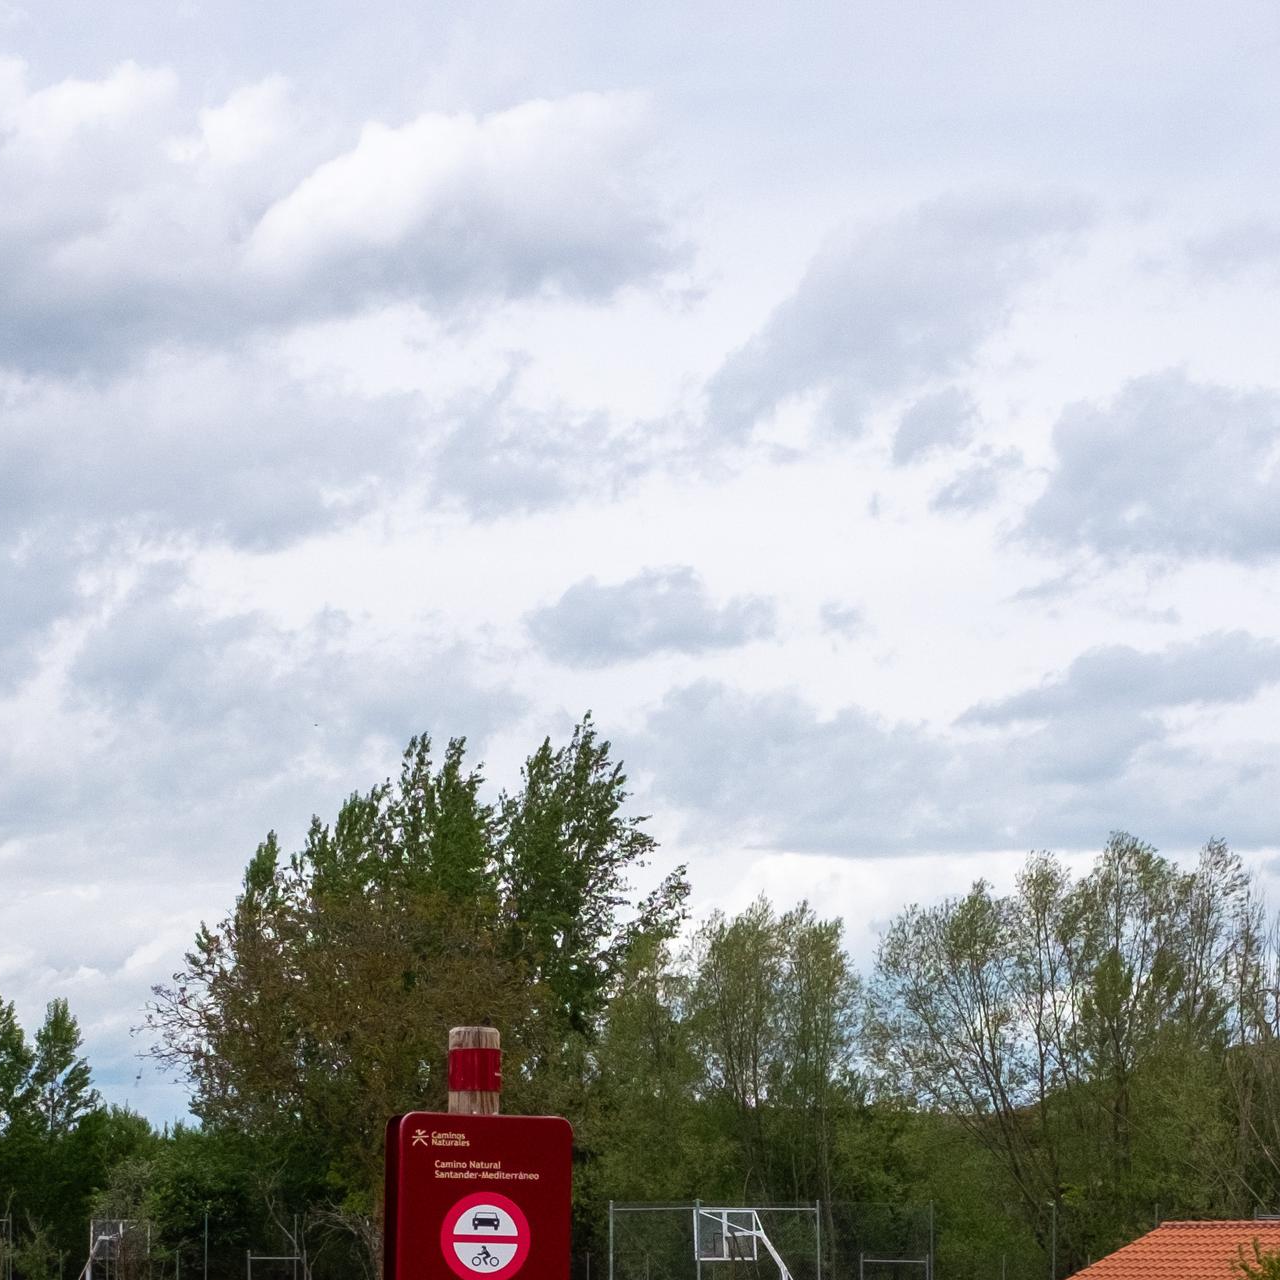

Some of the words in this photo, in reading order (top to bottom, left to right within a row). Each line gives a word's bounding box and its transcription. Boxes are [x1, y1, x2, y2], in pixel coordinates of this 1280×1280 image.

[431, 1131, 466, 1139] Caminos
[431, 1139, 471, 1147] Naturales
[434, 1159, 467, 1169] Camino
[469, 1160, 501, 1170] Natural
